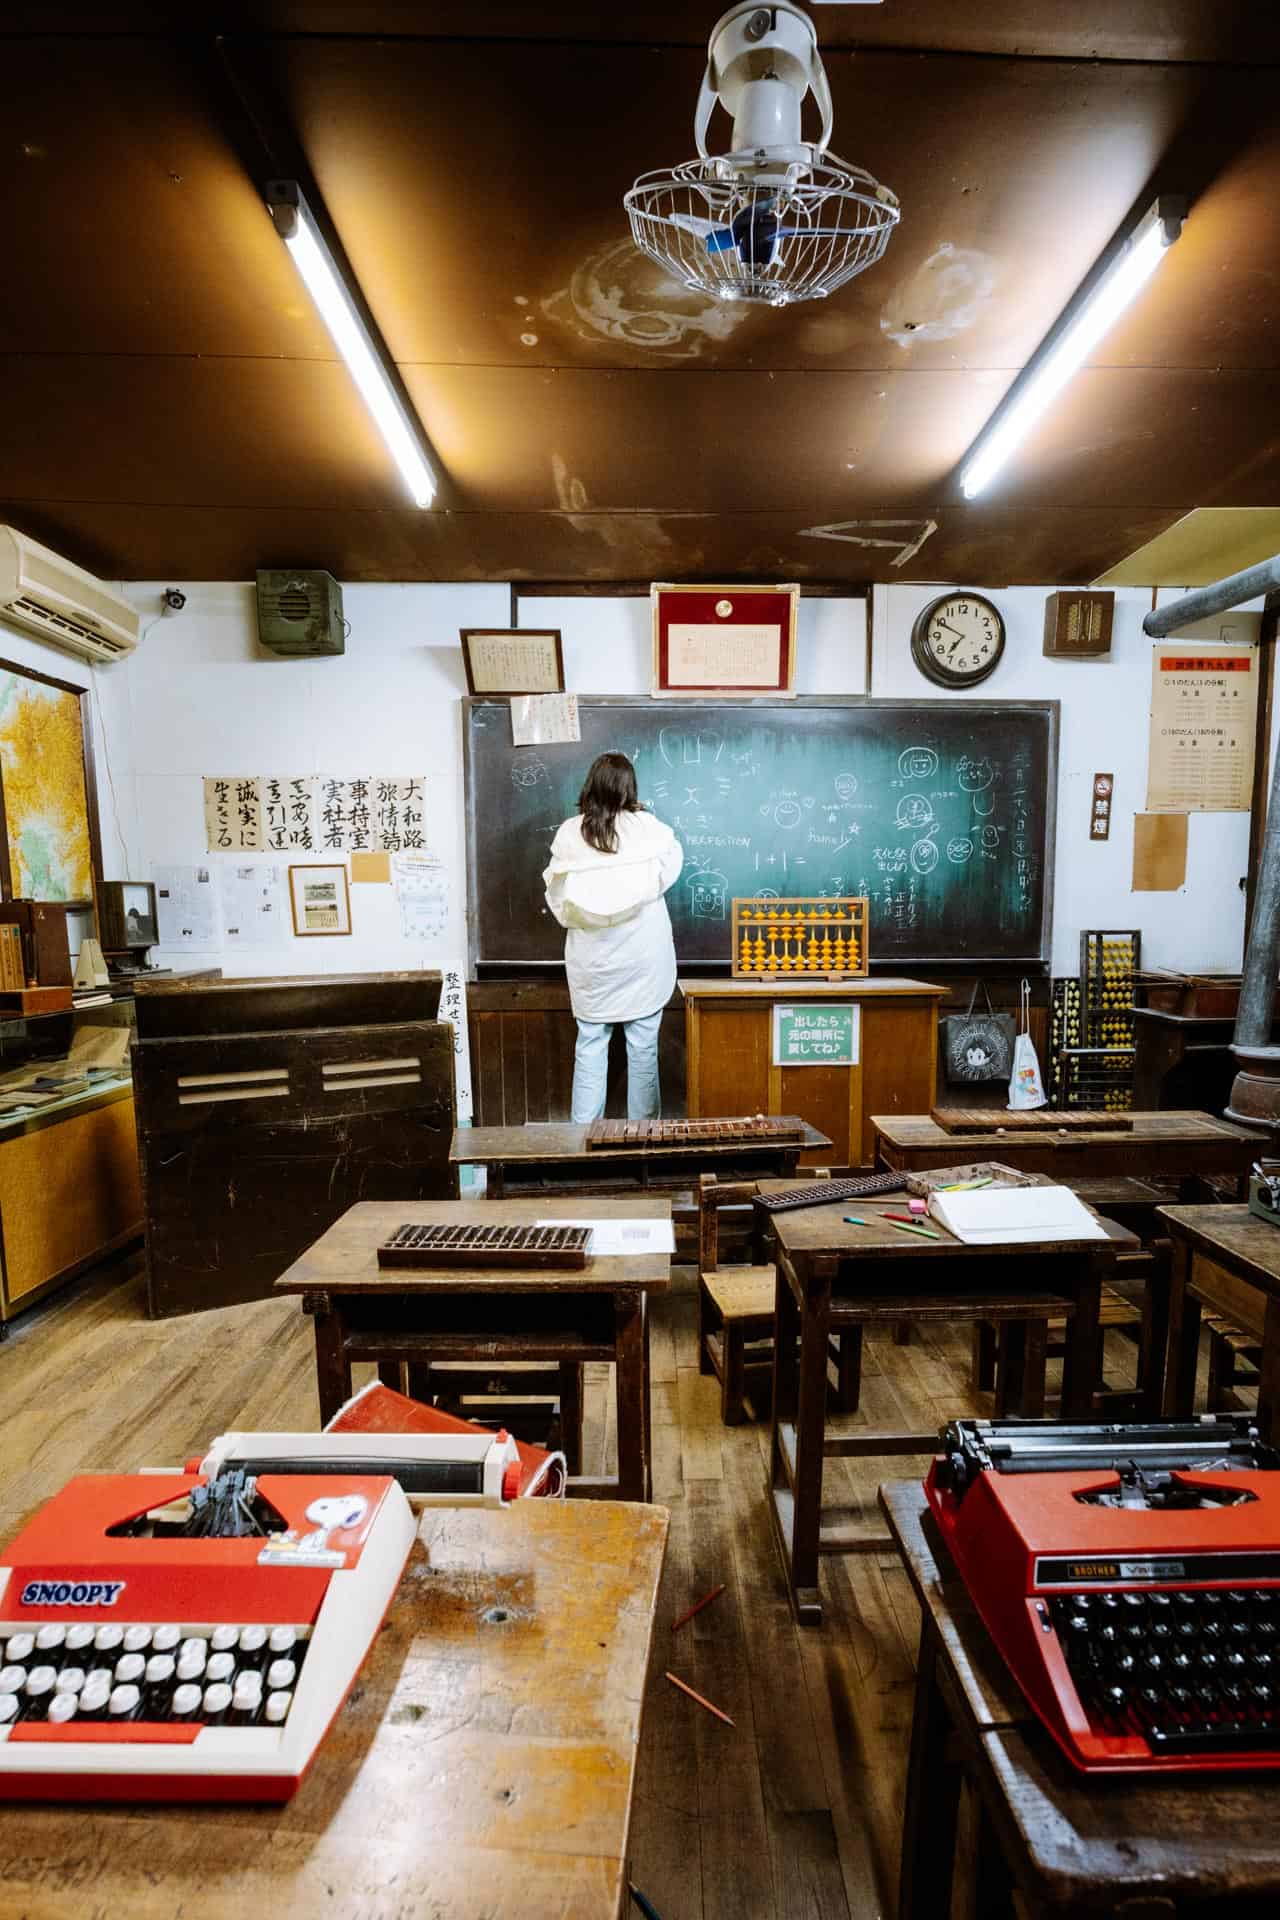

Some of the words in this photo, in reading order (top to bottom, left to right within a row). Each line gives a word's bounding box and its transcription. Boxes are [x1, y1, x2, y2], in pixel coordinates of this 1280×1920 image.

[946, 607, 954, 617] 11
[958, 604, 968, 614] 12
[936, 617, 946, 627] 10
[982, 617, 990, 627] 2
[933, 631, 941, 641] 9
[985, 631, 992, 640] 3
[936, 644, 945, 654] 8
[981, 644, 988, 653] 4
[947, 655, 954, 664] 7
[958, 657, 967, 667] 6
[972, 654, 980, 664] 5
[214, 782, 232, 847] 生きる
[235, 781, 259, 847] 誠実に
[377, 782, 401, 851] 旅情詩
[402, 779, 425, 849] 大和路
[1074, 1565, 1116, 1576] BROTHER
[22, 1582, 122, 1603] SNOOPY
